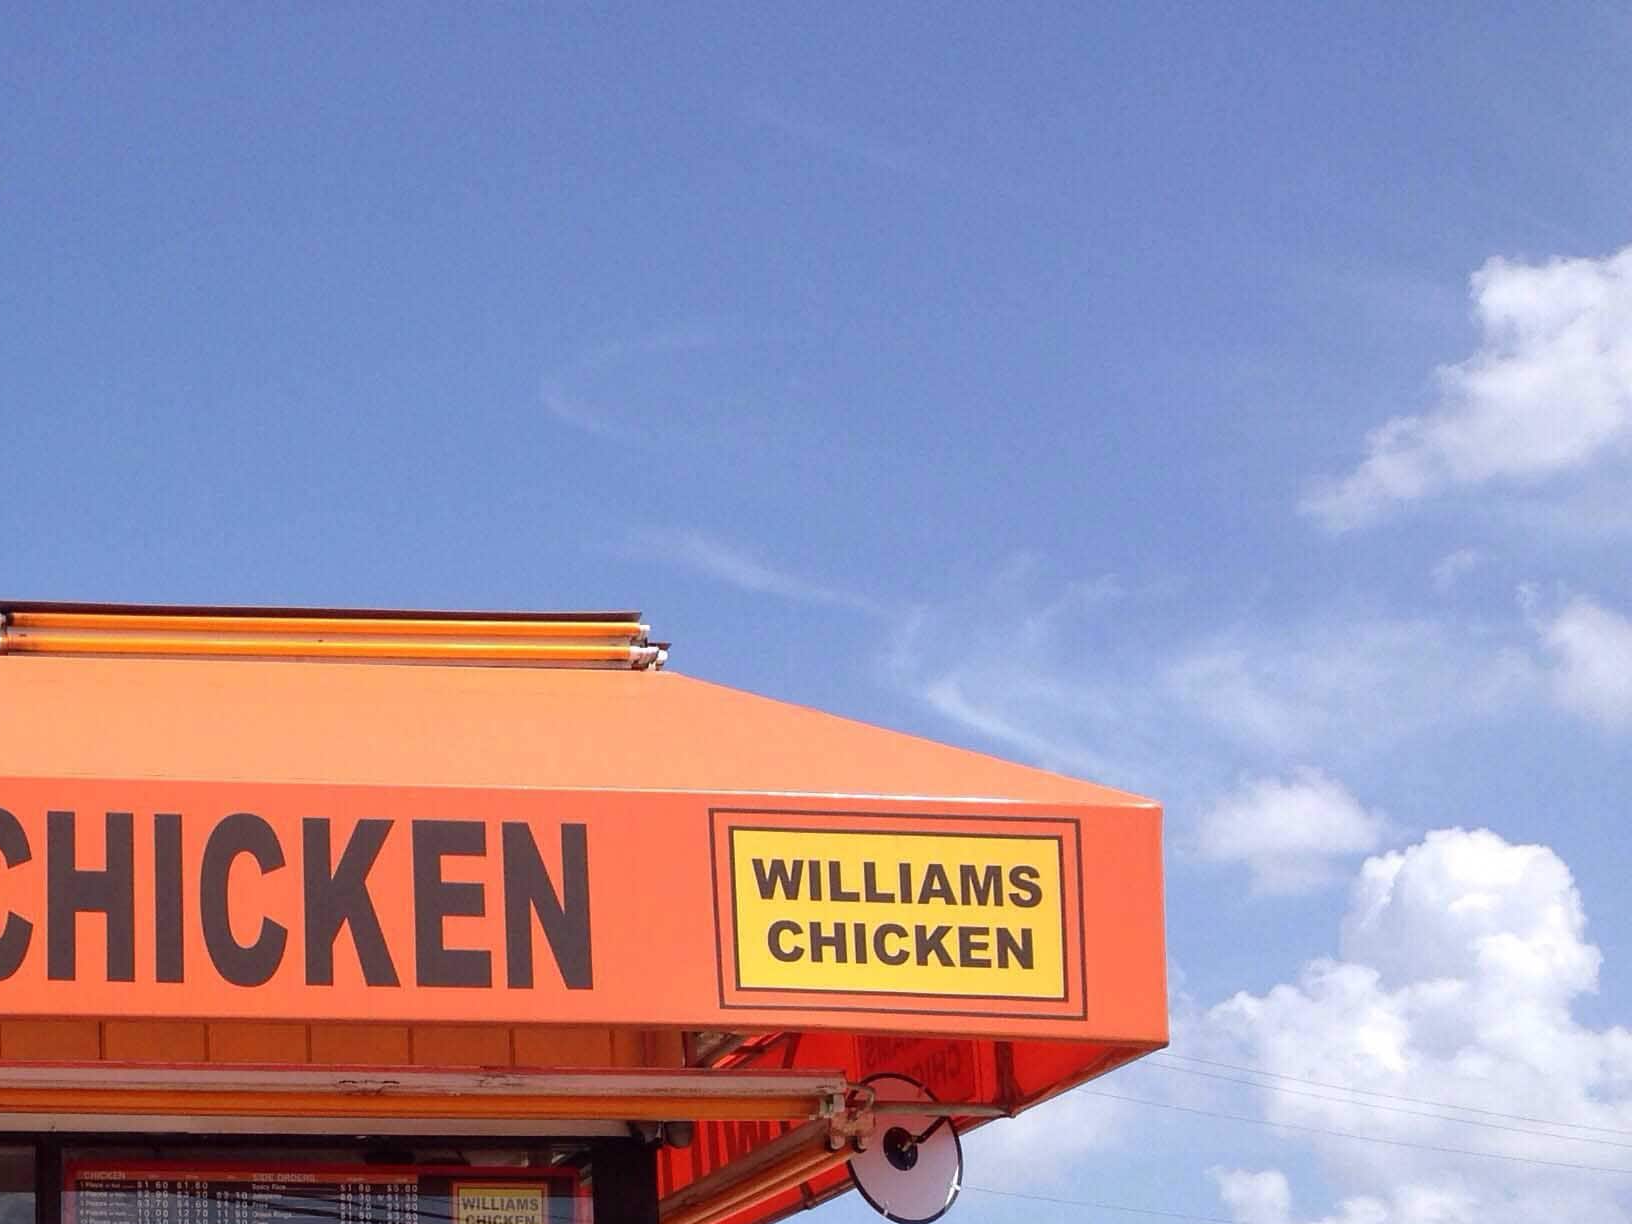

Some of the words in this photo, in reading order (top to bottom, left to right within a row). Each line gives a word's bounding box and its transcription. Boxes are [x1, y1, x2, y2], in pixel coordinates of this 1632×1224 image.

[752, 858, 1043, 908] WILLIAMS
[768, 920, 1034, 970] CHICKEN
[462, 1197, 539, 1212] WILLIAMS
